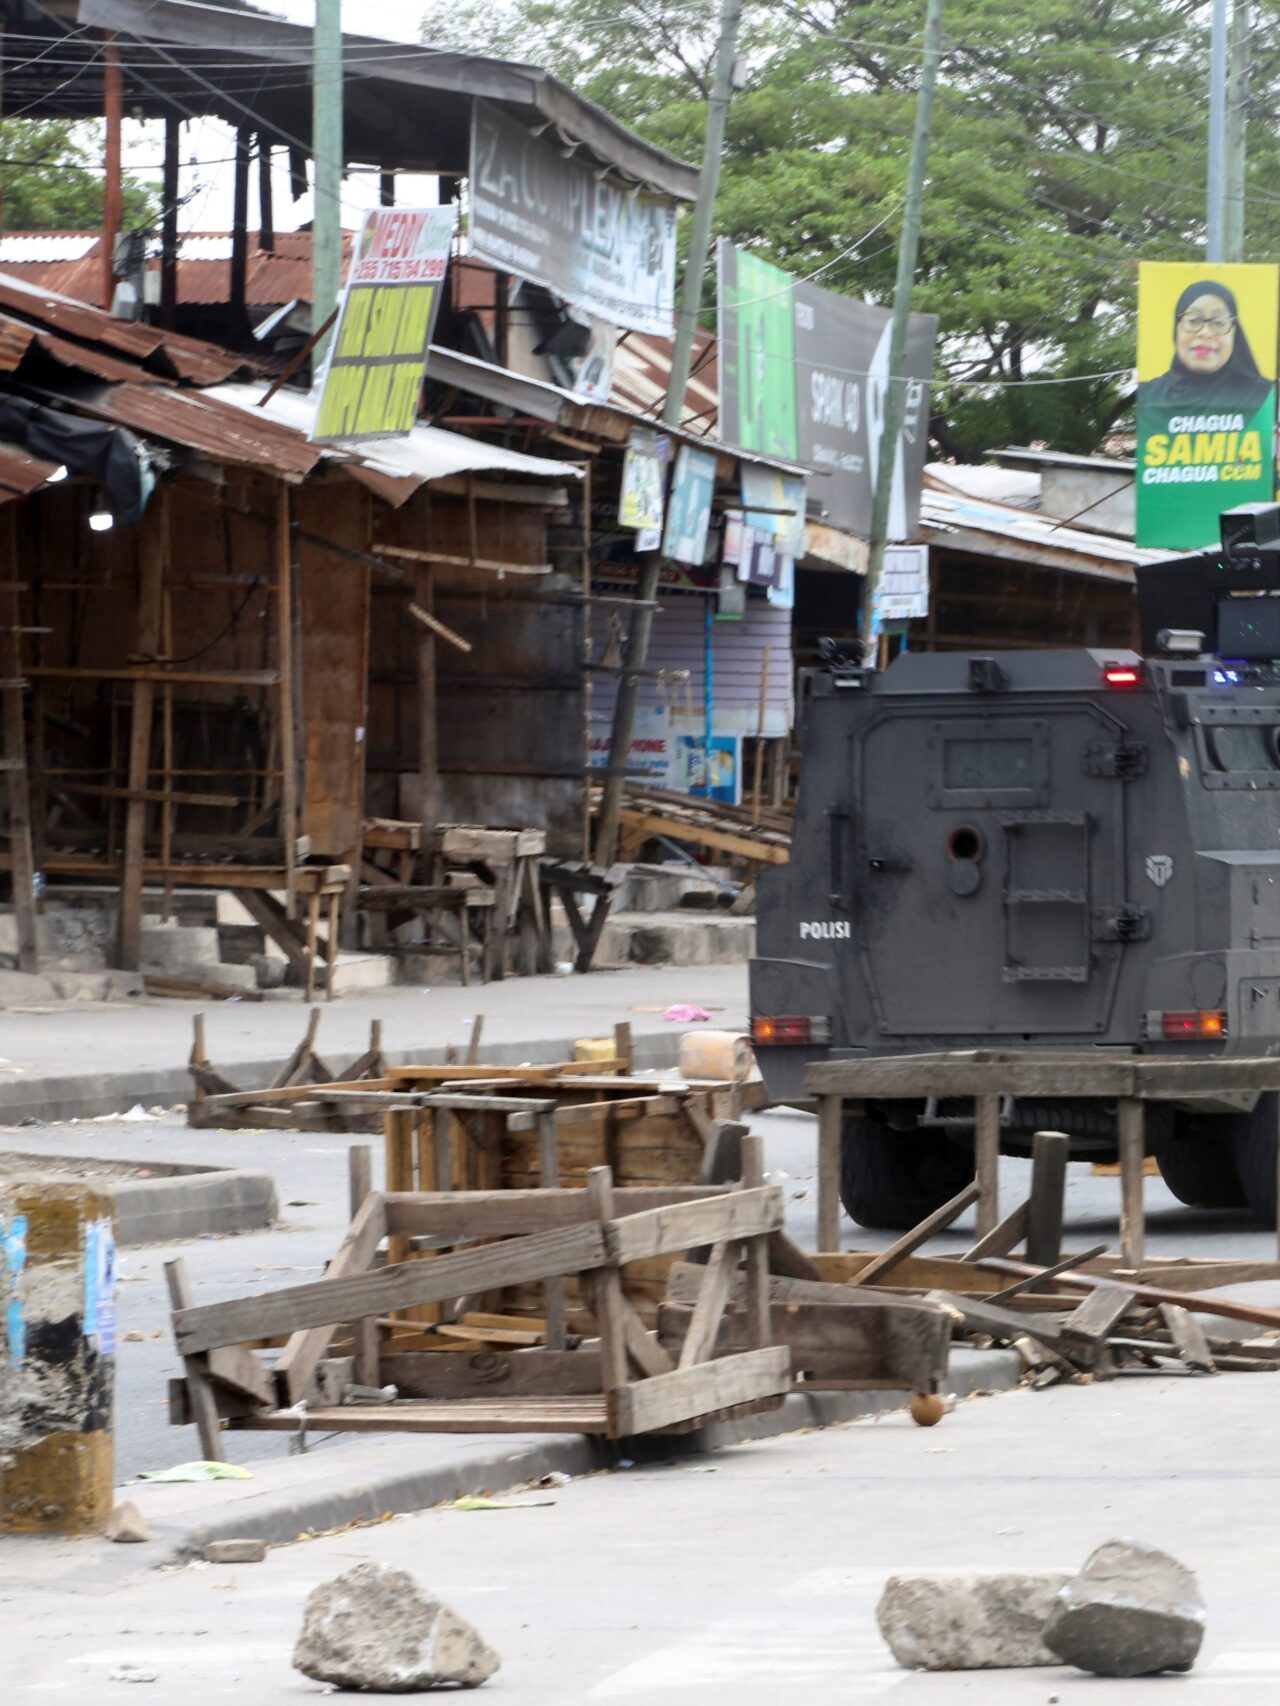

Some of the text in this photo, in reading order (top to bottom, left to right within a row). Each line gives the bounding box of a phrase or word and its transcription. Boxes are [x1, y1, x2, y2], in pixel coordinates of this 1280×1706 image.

[1168, 414, 1244, 433] CHAGUA
[1143, 431, 1262, 466] SAMIA
[1142, 464, 1262, 484] CHAGUA CCM
[800, 921, 850, 939] POLISI
